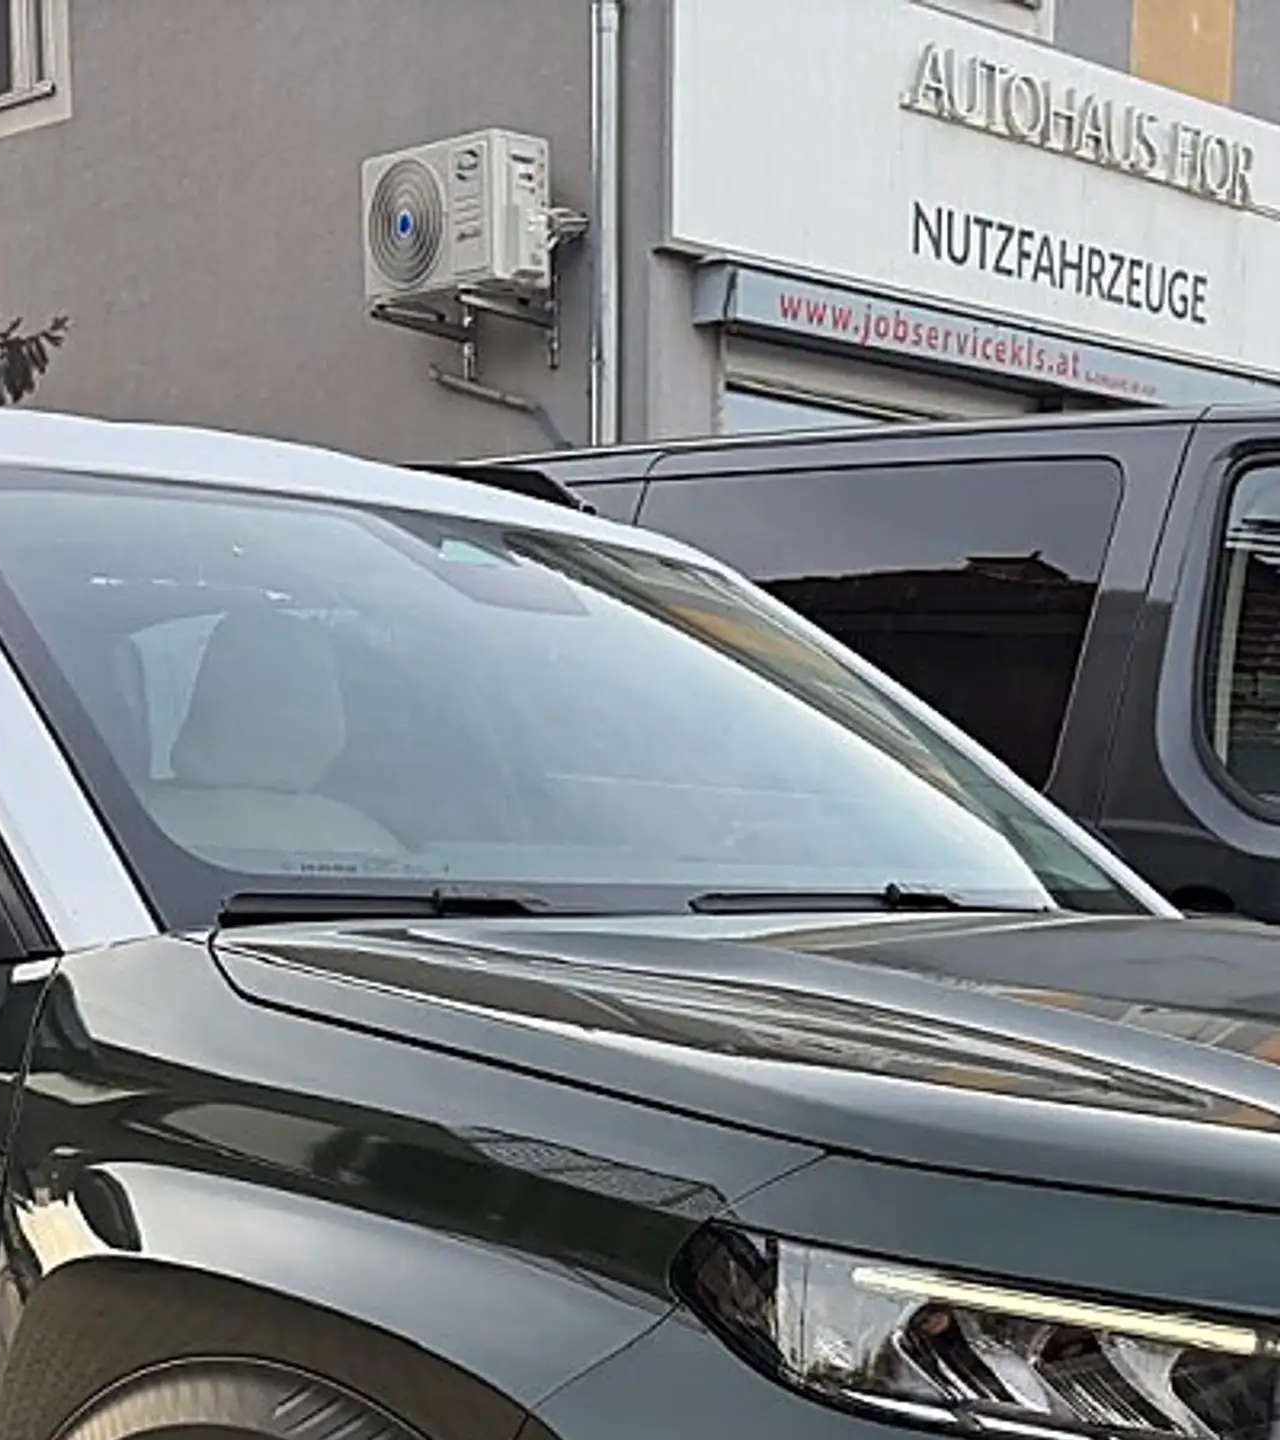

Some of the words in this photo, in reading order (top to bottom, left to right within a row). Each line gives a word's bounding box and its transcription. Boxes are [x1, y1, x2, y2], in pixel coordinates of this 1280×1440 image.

[900, 42, 1159, 171] AUTOHAUS
[912, 200, 1209, 325] NUTZFAHRZEUGE
[779, 291, 1081, 379] www.jobservicekls.at
